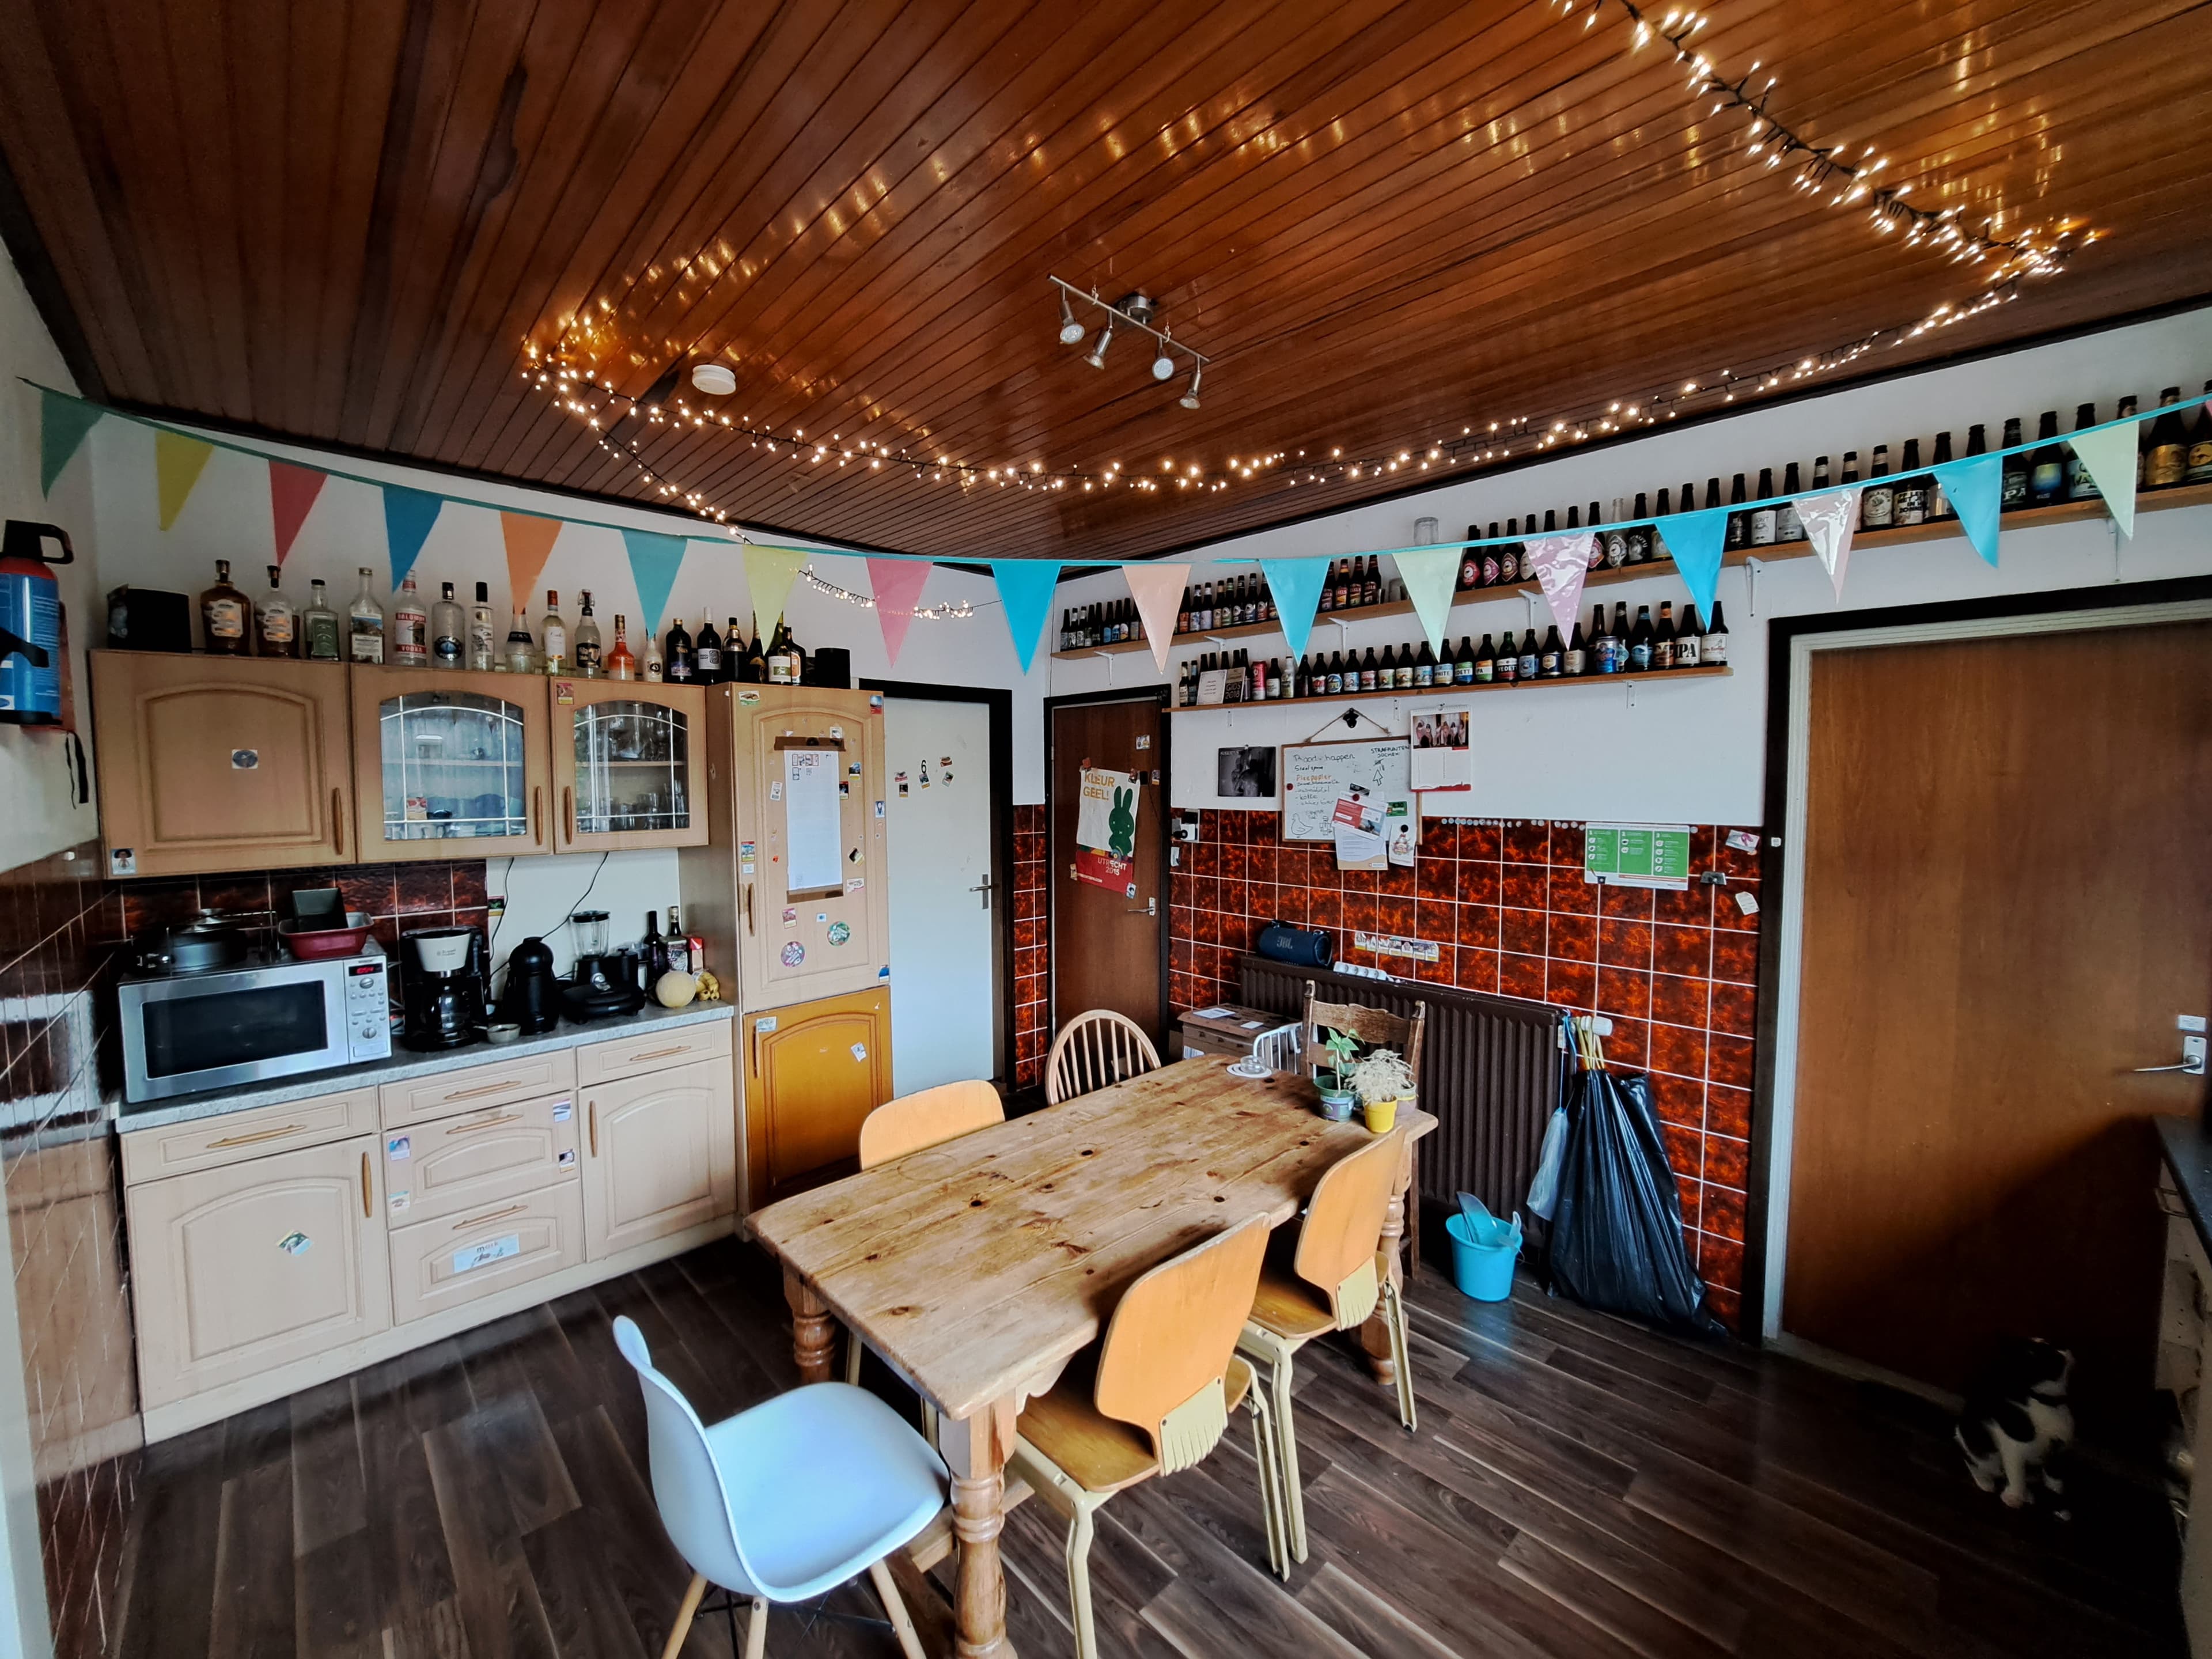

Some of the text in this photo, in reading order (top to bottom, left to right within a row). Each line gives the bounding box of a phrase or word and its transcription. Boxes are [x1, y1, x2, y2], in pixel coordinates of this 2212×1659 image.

[1676, 643, 1696, 658] IPA
[1226, 683, 1241, 691] GIDS
[1225, 691, 1240, 699] 2018
[921, 759, 927, 774] 6
[1084, 772, 1115, 787] KLEUR
[1084, 786, 1109, 800] GEEL!
[1097, 857, 1127, 871] UTRECHT
[1105, 866, 1120, 876] 2015
[1277, 936, 1293, 949] JBL
